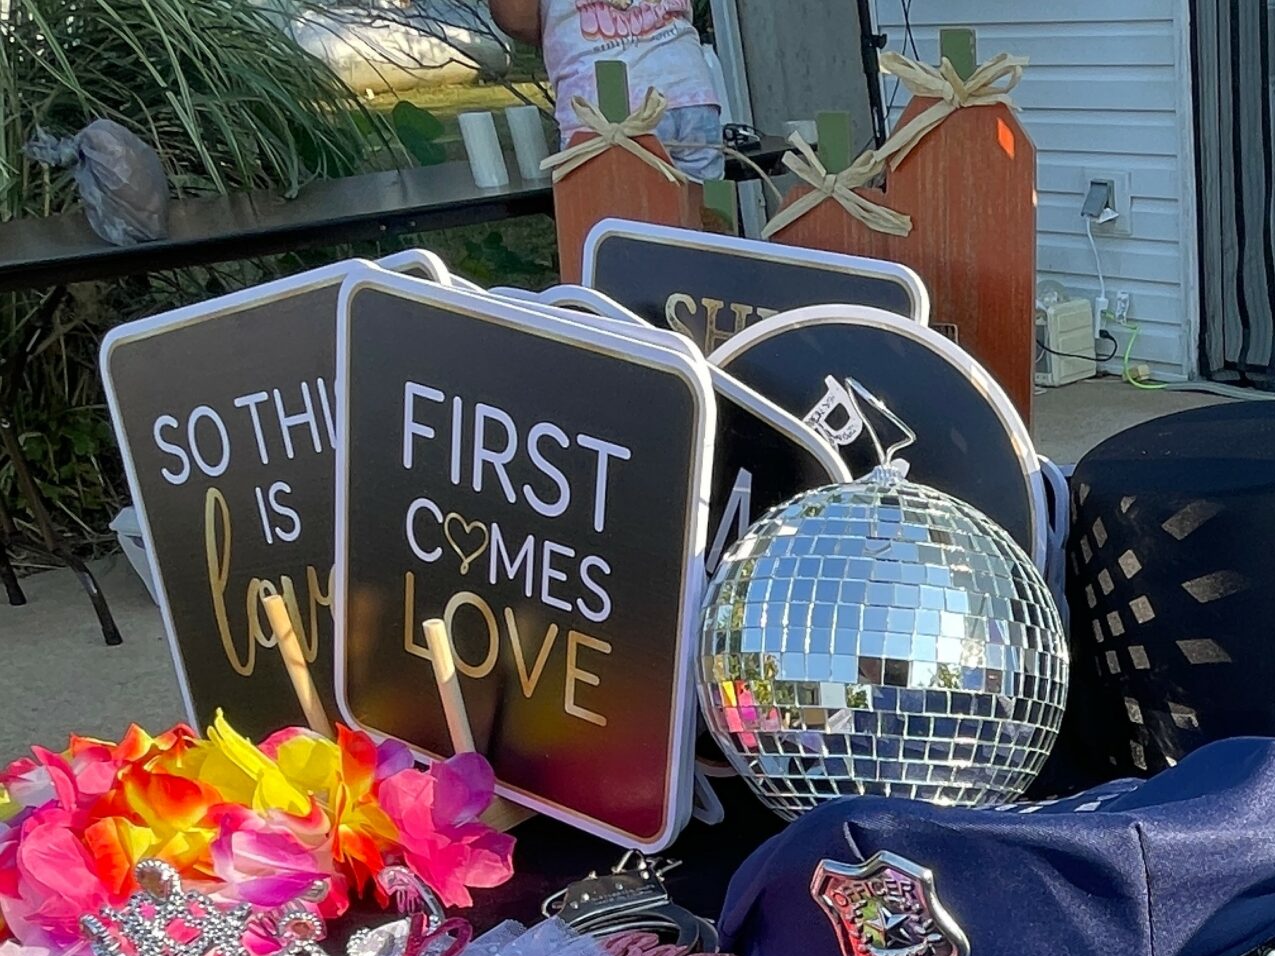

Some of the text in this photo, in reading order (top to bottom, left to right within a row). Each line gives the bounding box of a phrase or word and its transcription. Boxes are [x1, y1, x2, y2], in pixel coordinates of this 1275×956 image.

[153, 376, 337, 485] SO THI
[403, 380, 632, 532] FIRST
[254, 480, 302, 545] IS
[205, 486, 336, 676] lov
[403, 570, 613, 727] LOVE
[832, 878, 918, 907] OFFICER
